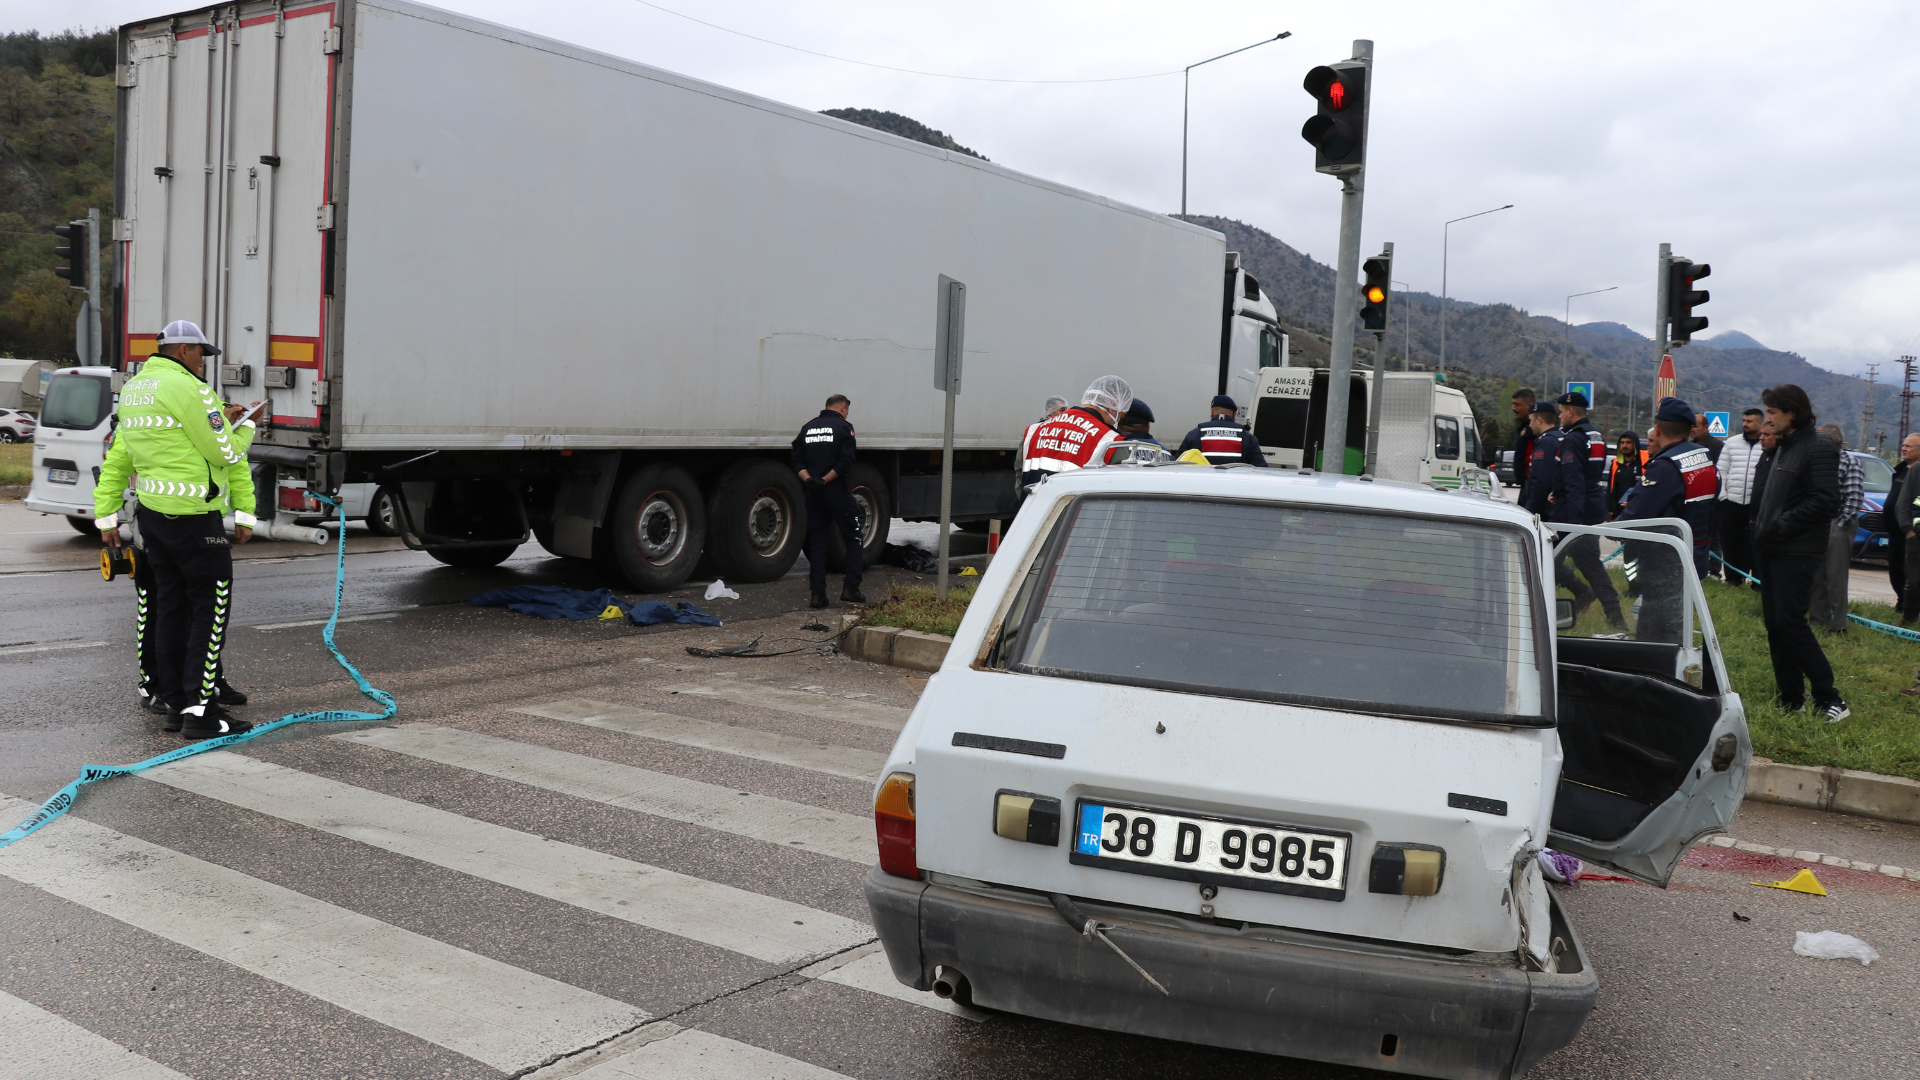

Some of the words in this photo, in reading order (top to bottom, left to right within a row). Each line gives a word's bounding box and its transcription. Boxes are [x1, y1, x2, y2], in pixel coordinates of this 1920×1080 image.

[1274, 377, 1306, 385] AMASYA
[1266, 386, 1301, 396] CENAZE
[1658, 376, 1674, 398] DUR
[806, 427, 833, 436] AMASYA
[1039, 427, 1063, 437] OLAY
[1082, 833, 1099, 846] TR
[1101, 812, 1156, 857] 38
[1174, 822, 1202, 863] D
[1220, 829, 1336, 881] 9985
